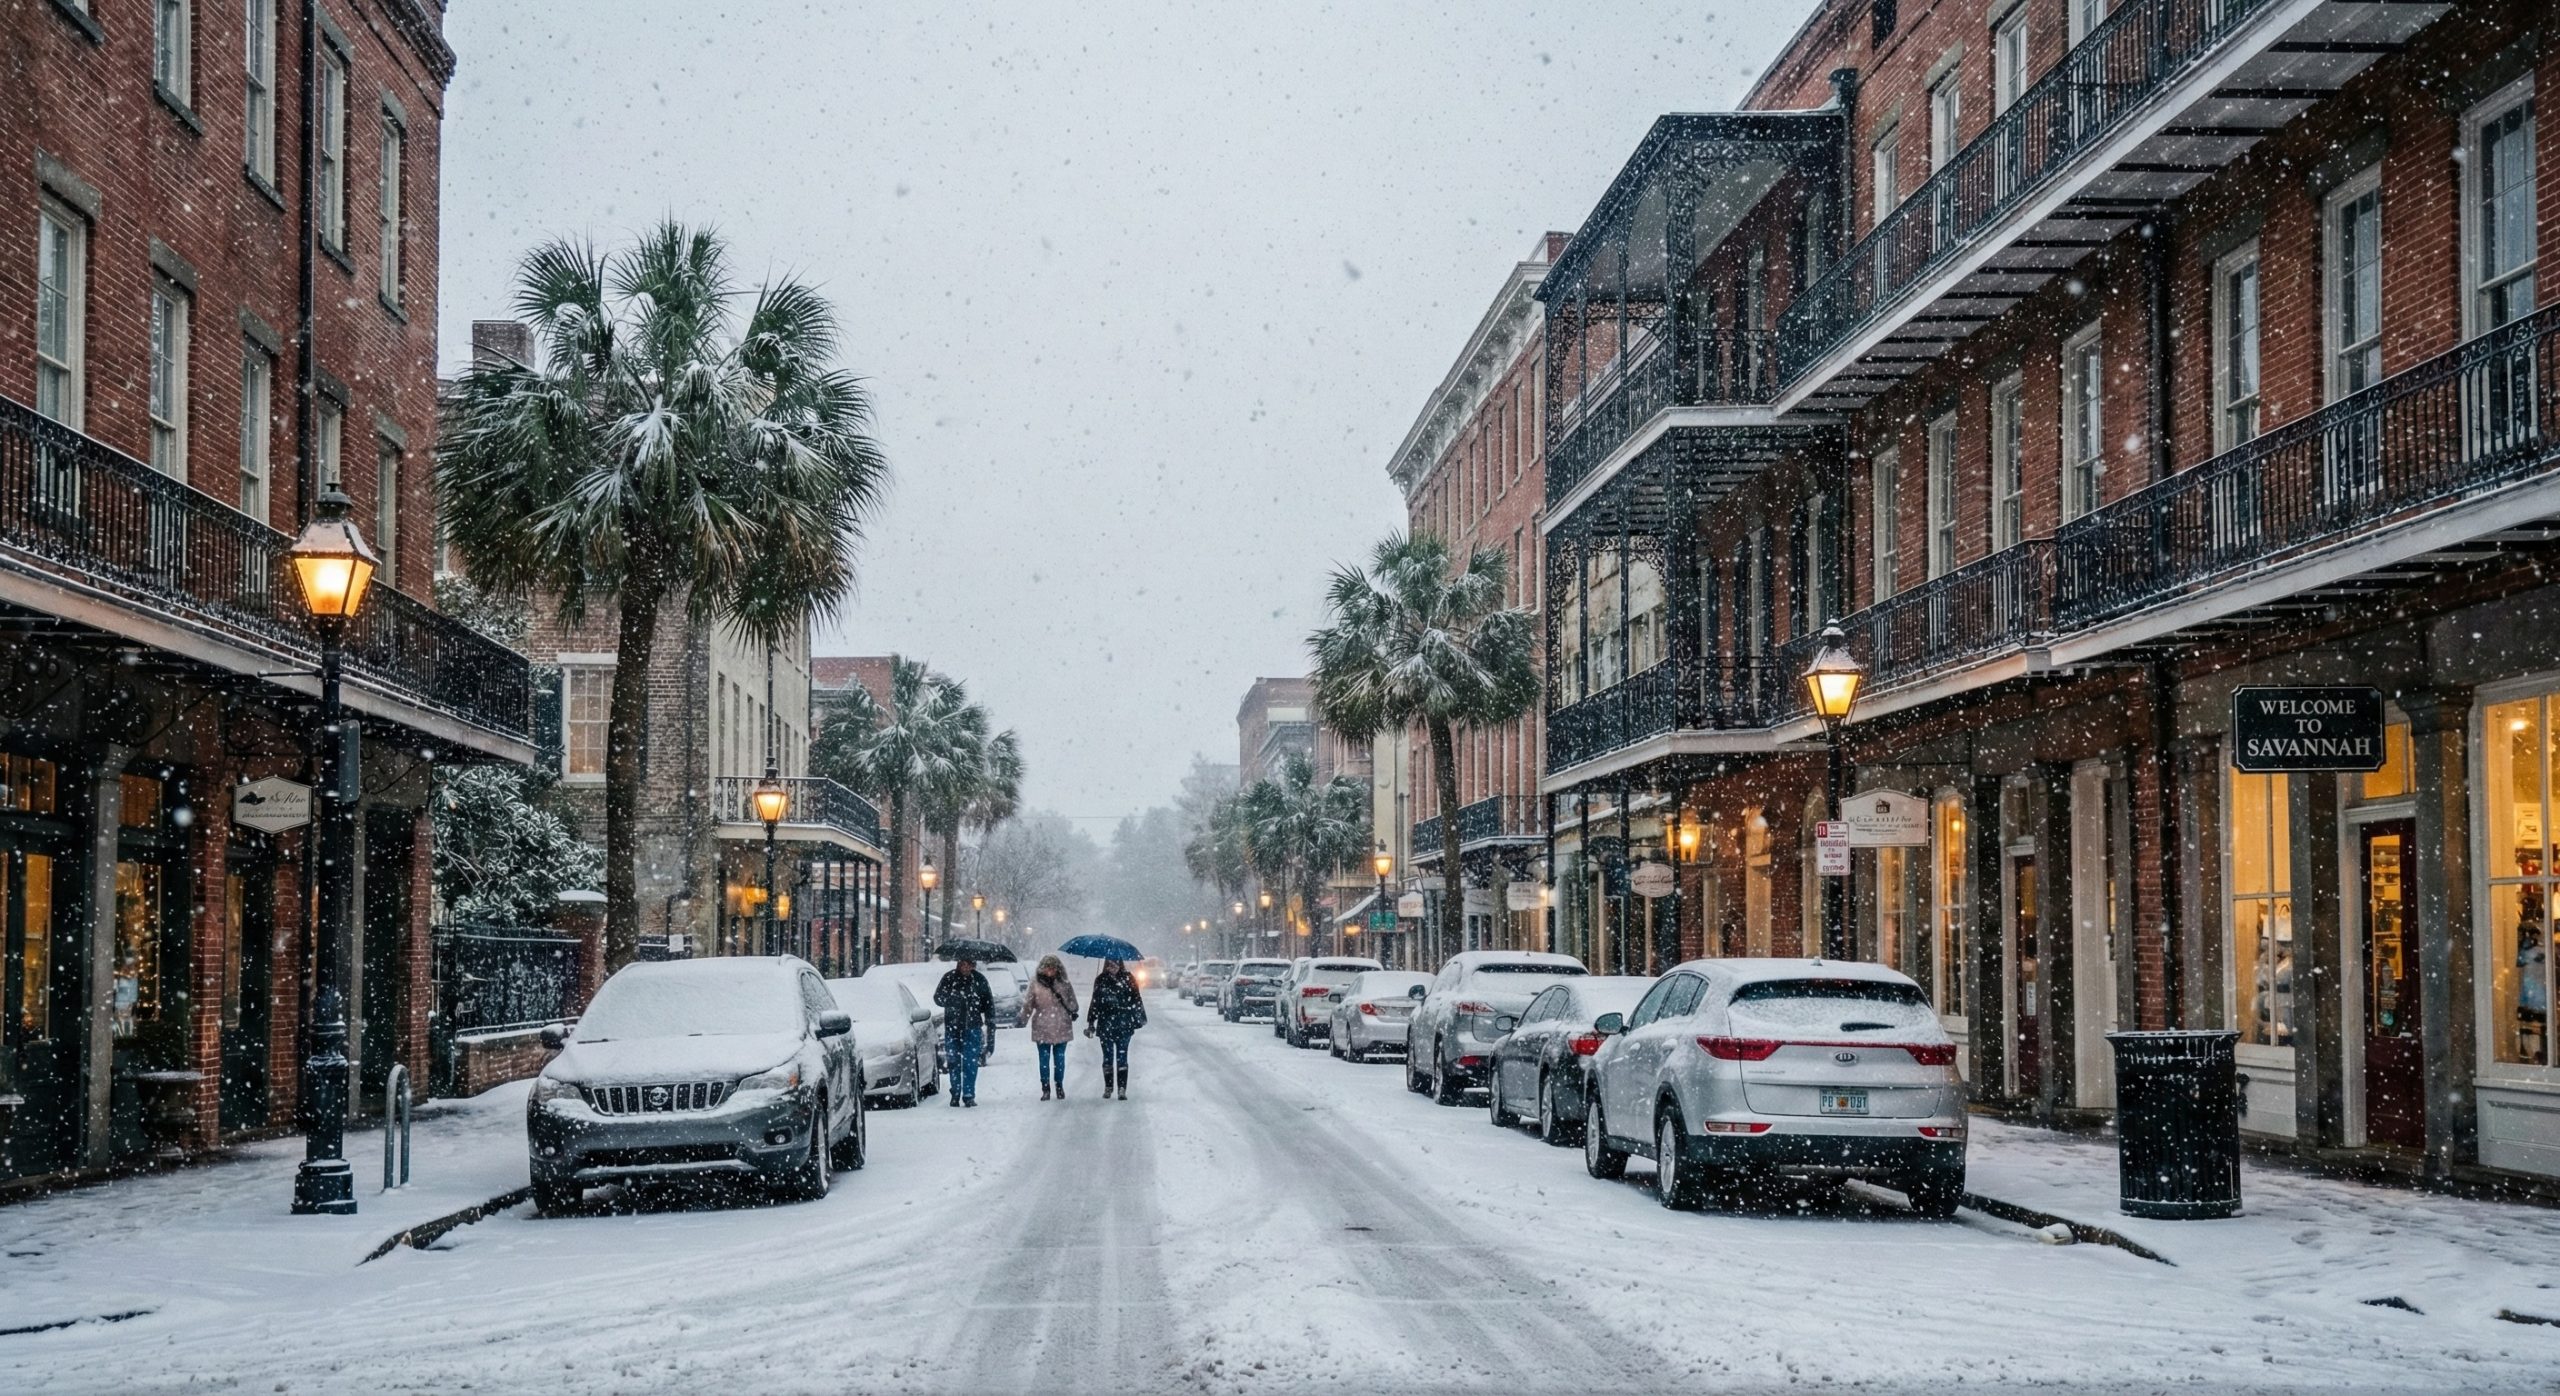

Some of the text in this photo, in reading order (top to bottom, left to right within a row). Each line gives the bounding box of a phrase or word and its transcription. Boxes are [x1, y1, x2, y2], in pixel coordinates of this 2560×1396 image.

[2260, 700, 2356, 715] WELCOME
[2295, 719, 2322, 734] TO
[2247, 737, 2372, 757] SAVANNAH
